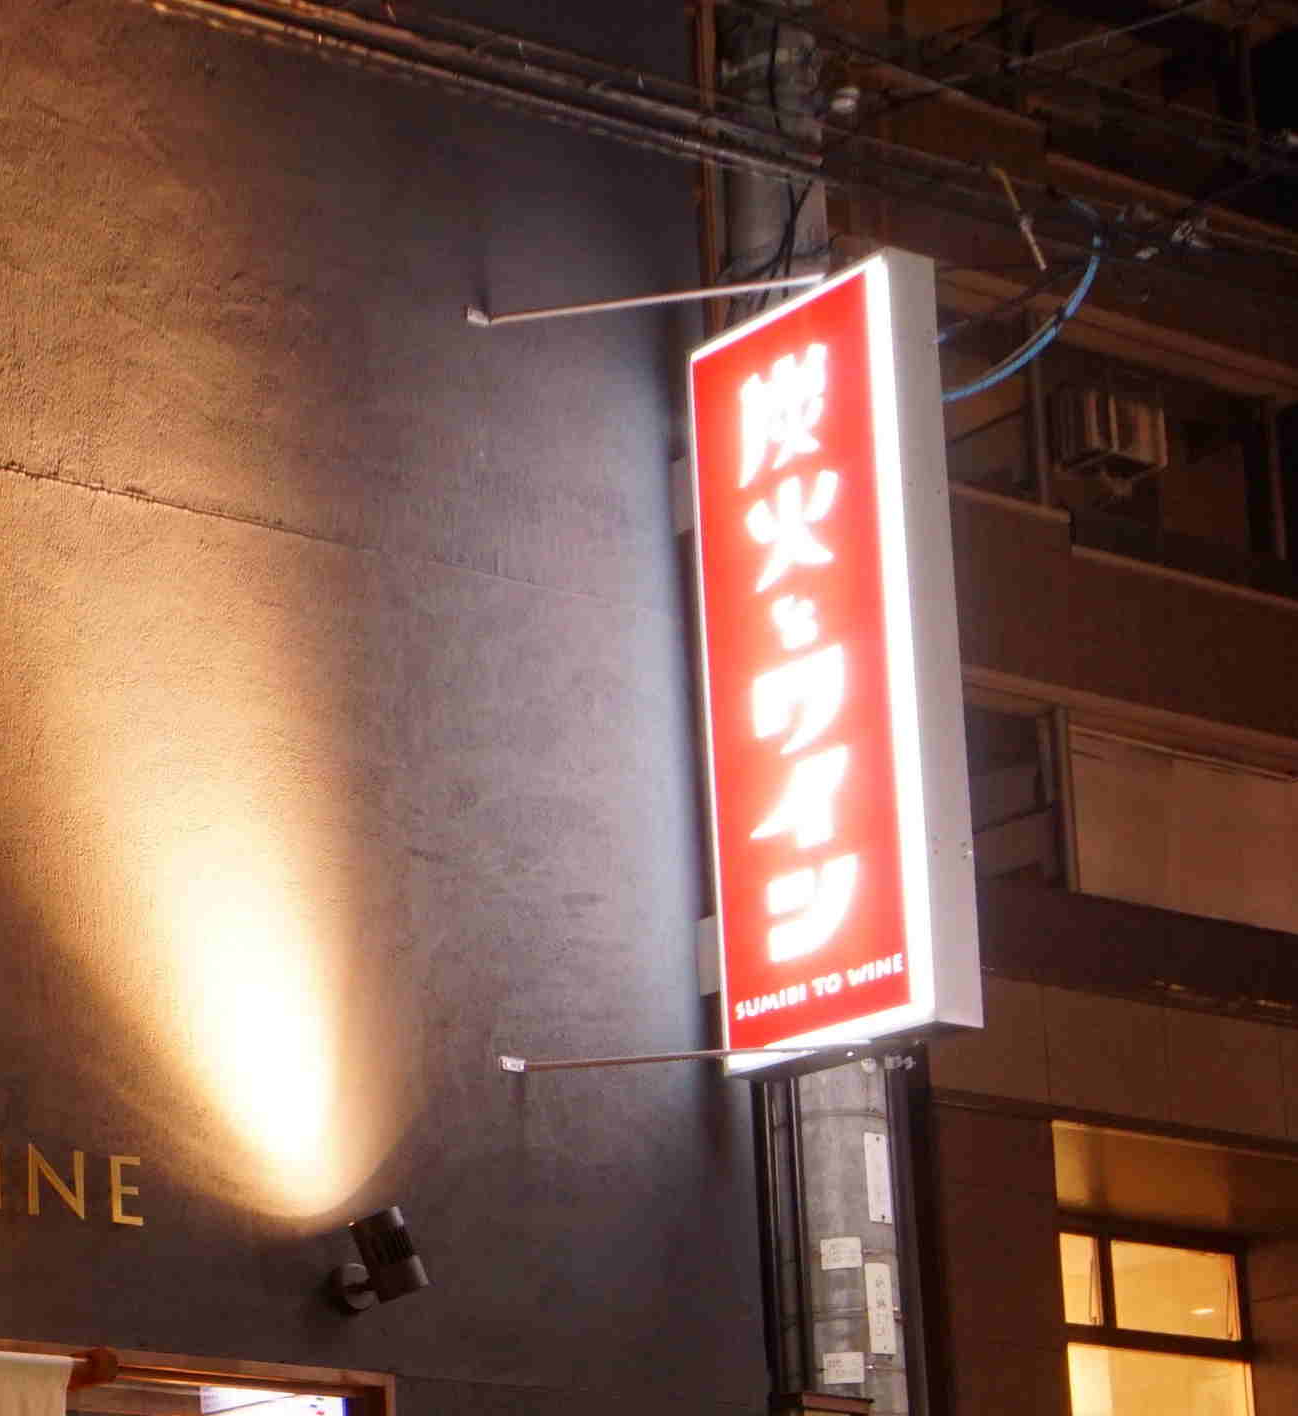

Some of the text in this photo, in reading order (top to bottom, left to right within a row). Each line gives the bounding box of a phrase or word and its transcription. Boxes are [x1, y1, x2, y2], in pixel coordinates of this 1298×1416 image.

[735, 952, 903, 1020] SUMIBI TO WINE
